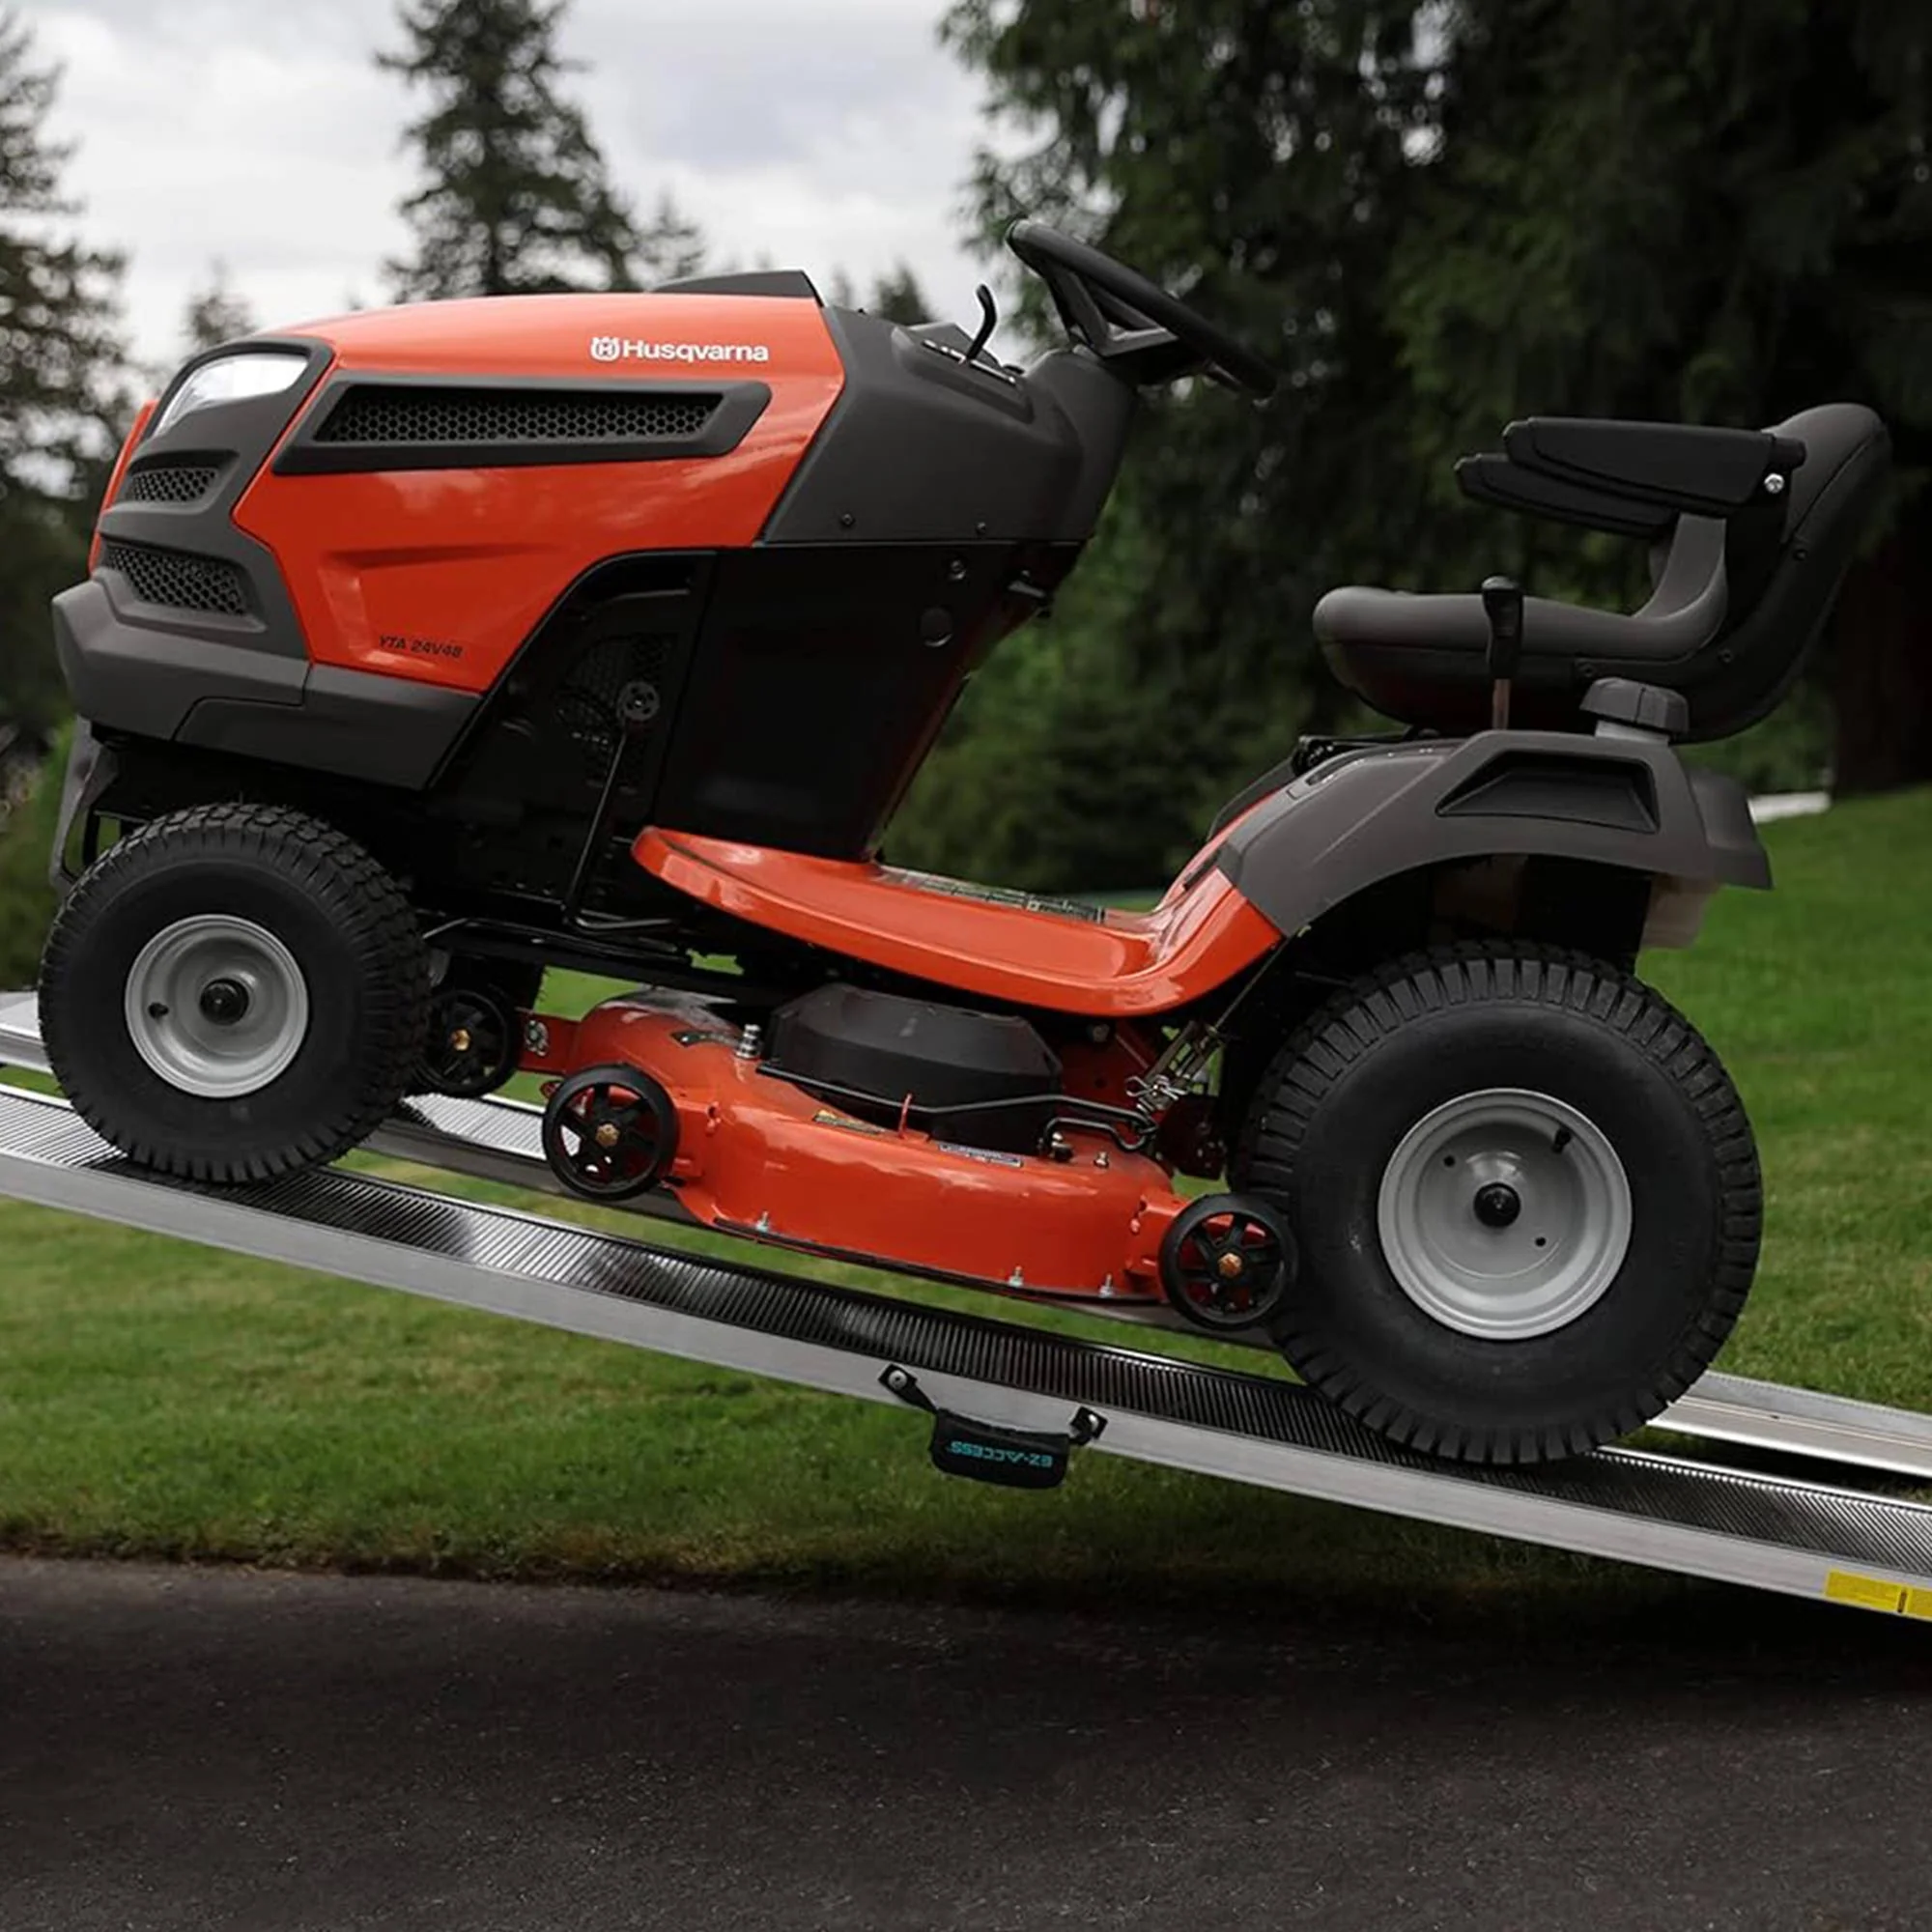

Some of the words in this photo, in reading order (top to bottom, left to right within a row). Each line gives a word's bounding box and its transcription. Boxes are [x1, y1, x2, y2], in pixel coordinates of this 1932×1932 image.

[623, 339, 769, 362] Husqvarna
[379, 635, 406, 650] YTA
[950, 1440, 1054, 1467] EZ-ACCESS
